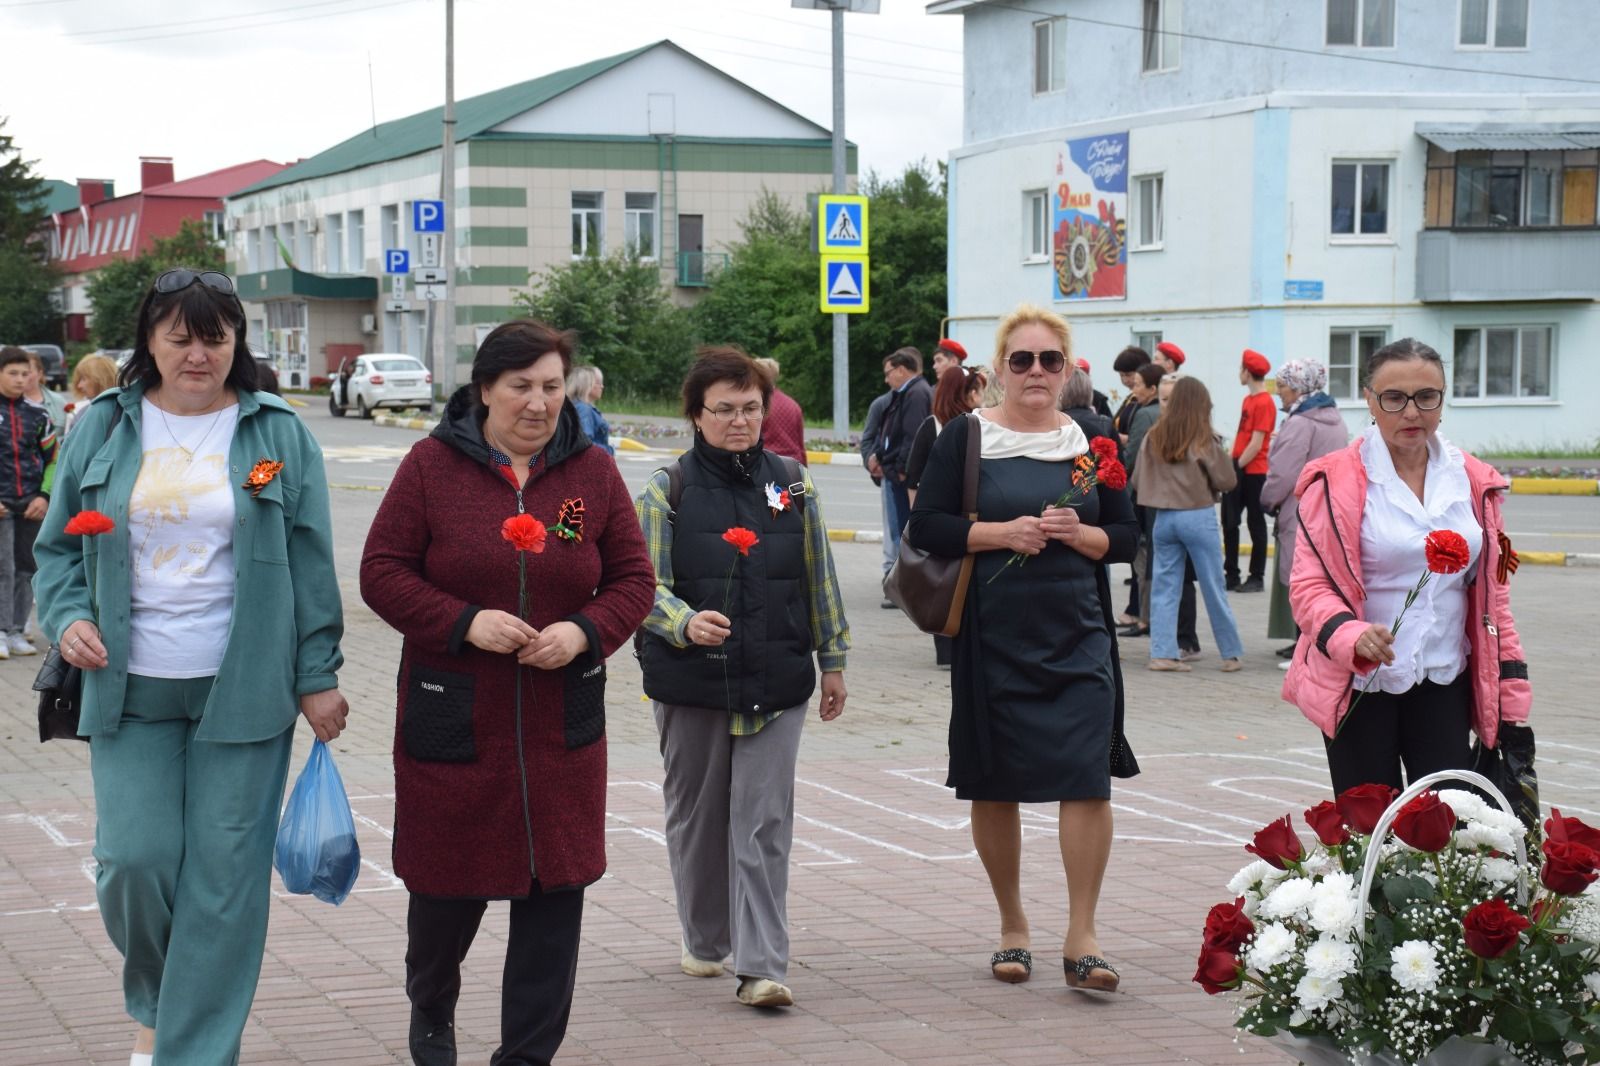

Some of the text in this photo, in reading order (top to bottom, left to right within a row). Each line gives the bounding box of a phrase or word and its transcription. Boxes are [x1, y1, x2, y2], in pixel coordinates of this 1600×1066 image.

[1057, 182, 1070, 209] 9
[419, 203, 438, 230] P
[390, 251, 405, 271] P
